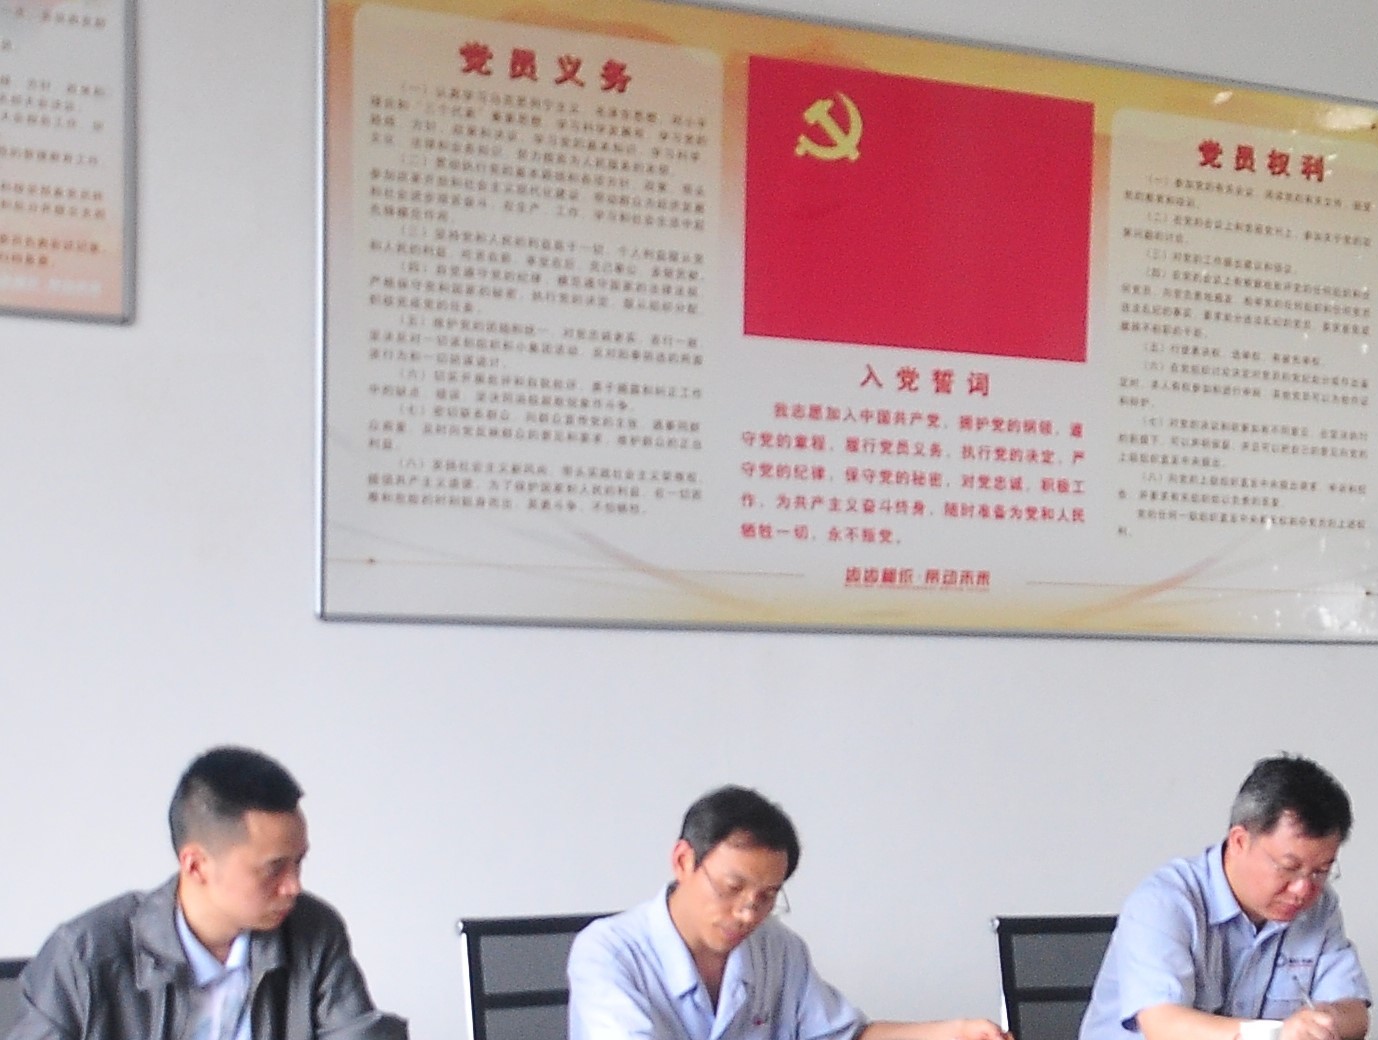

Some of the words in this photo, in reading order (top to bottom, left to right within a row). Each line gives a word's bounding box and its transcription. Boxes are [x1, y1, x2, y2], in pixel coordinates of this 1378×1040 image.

[459, 41, 632, 93] 党员义务
[1198, 139, 1325, 183] 党员权利
[860, 363, 990, 397] 入党誓词
